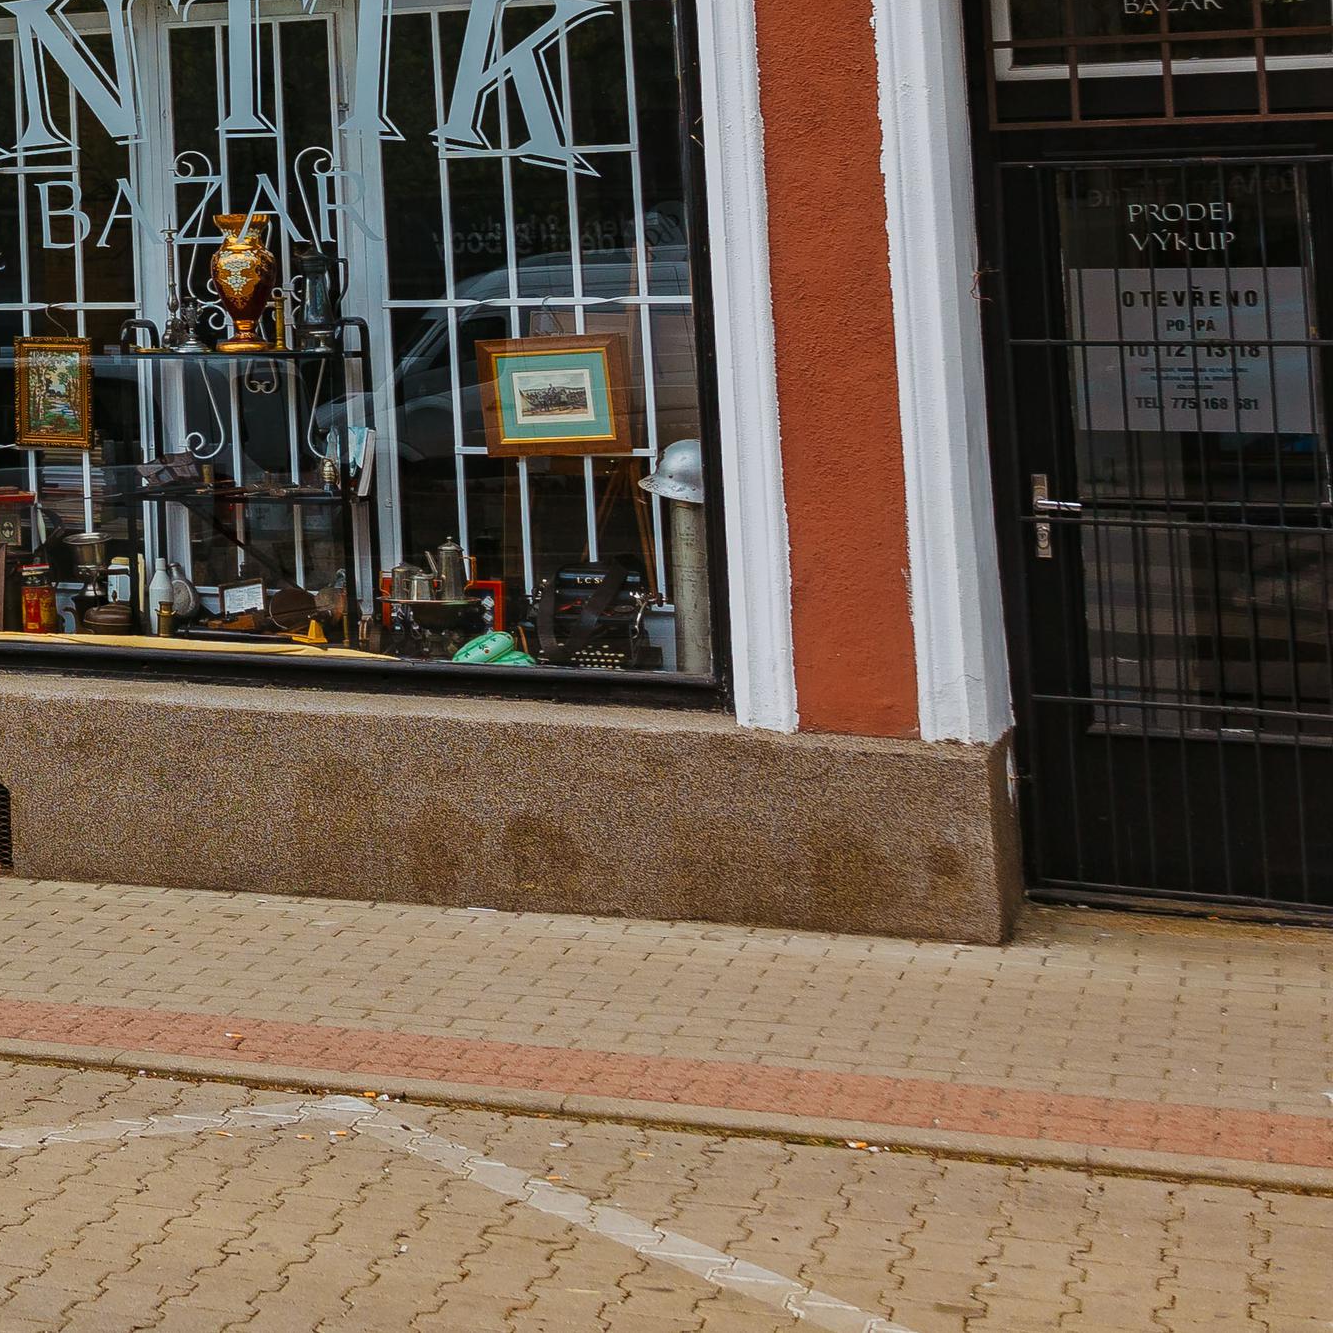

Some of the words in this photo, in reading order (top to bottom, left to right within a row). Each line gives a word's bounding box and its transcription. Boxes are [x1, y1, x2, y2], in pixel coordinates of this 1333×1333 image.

[35, 170, 383, 250] BAZAR
[1128, 202, 1234, 222] PRODEJ
[1129, 229, 1236, 251] VÝKUP
[1122, 286, 1258, 308] OTEVŘENO
[1203, 397, 1229, 409] 168
